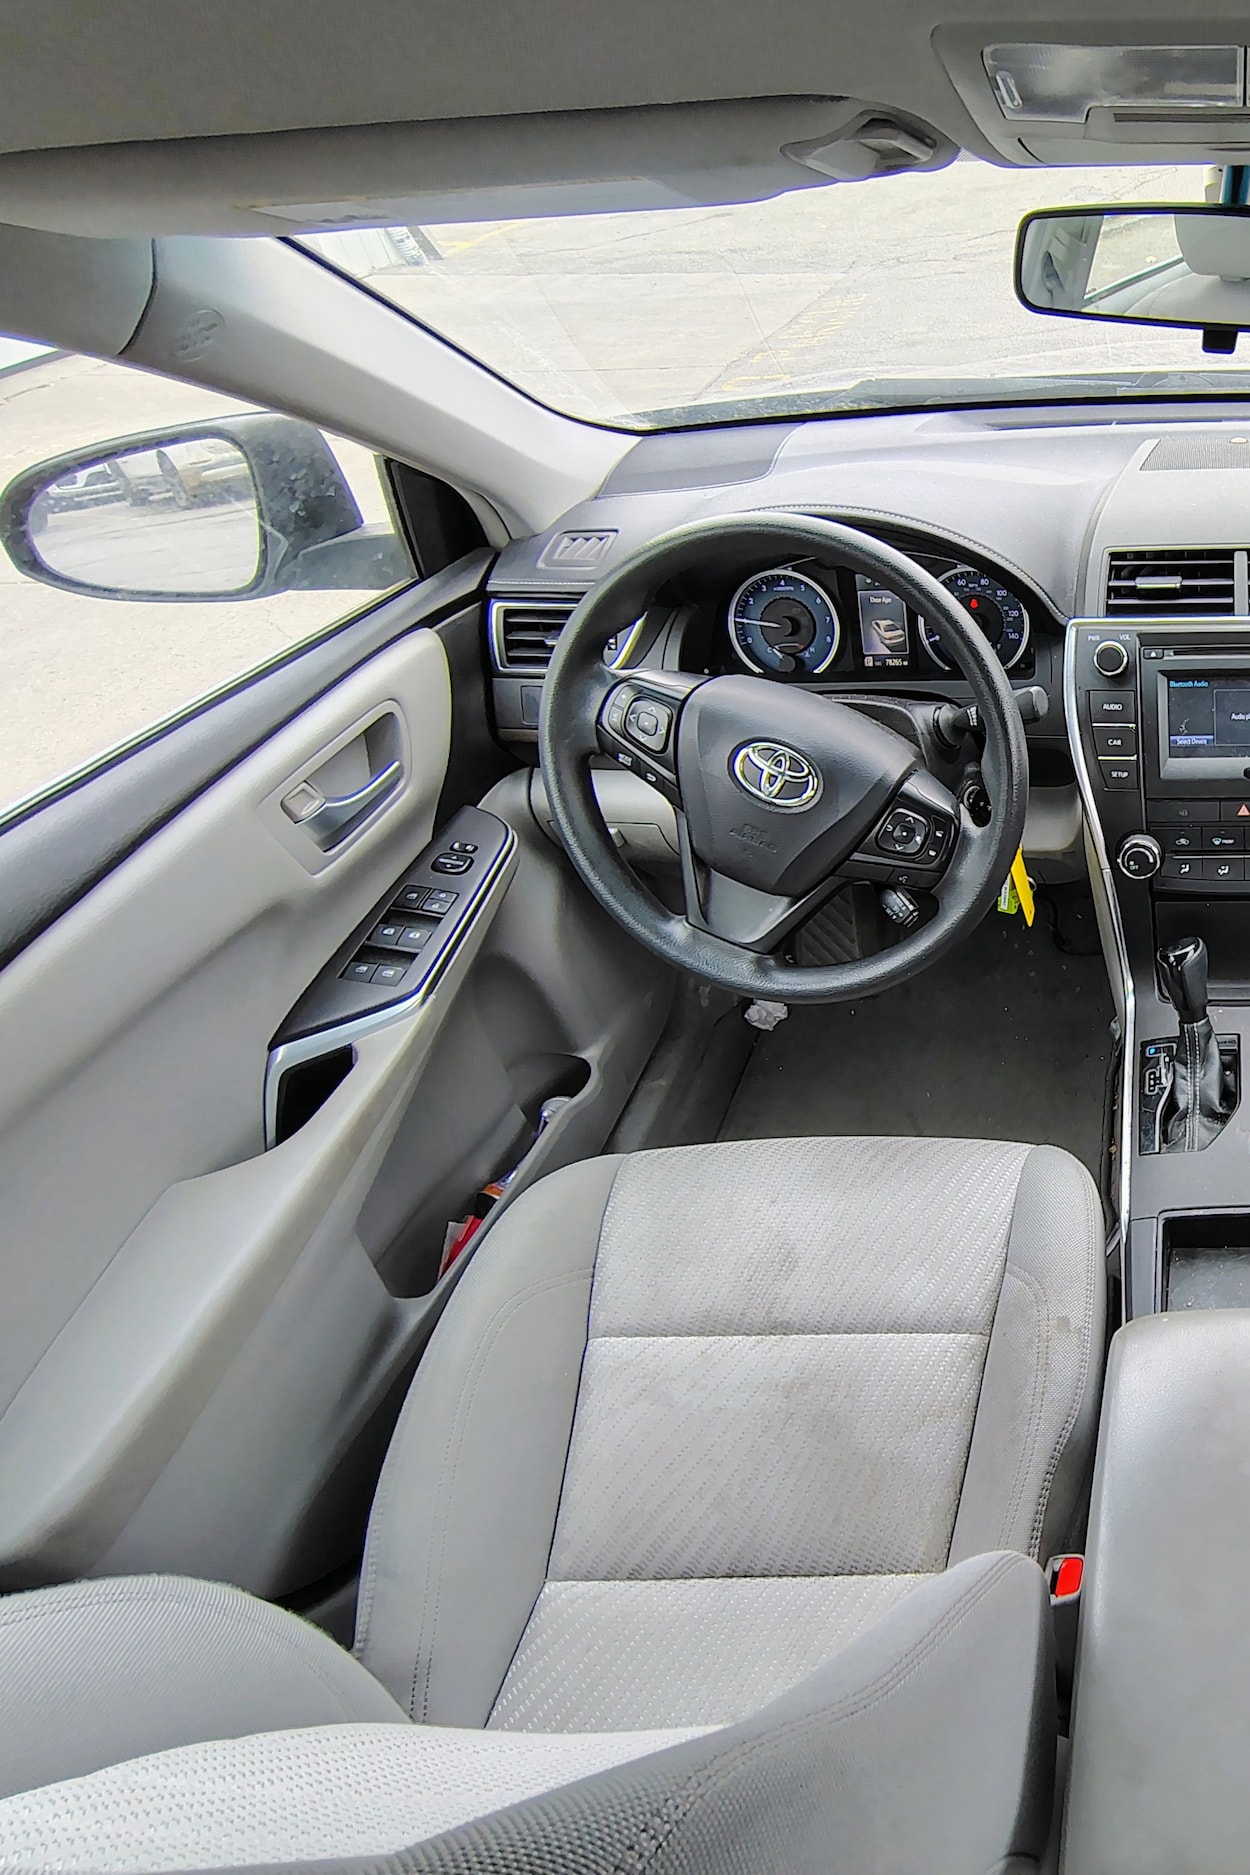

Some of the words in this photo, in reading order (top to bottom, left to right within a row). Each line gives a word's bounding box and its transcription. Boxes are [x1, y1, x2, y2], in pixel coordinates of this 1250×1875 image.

[980, 578, 990, 586] 80
[748, 597, 754, 605] 2
[825, 616, 831, 624] 7
[1008, 632, 1020, 640] 140
[1194, 680, 1208, 688] Audio
[1102, 703, 1123, 711] AUDIO
[1107, 738, 1122, 746] CAR
[1176, 737, 1191, 745] Select
